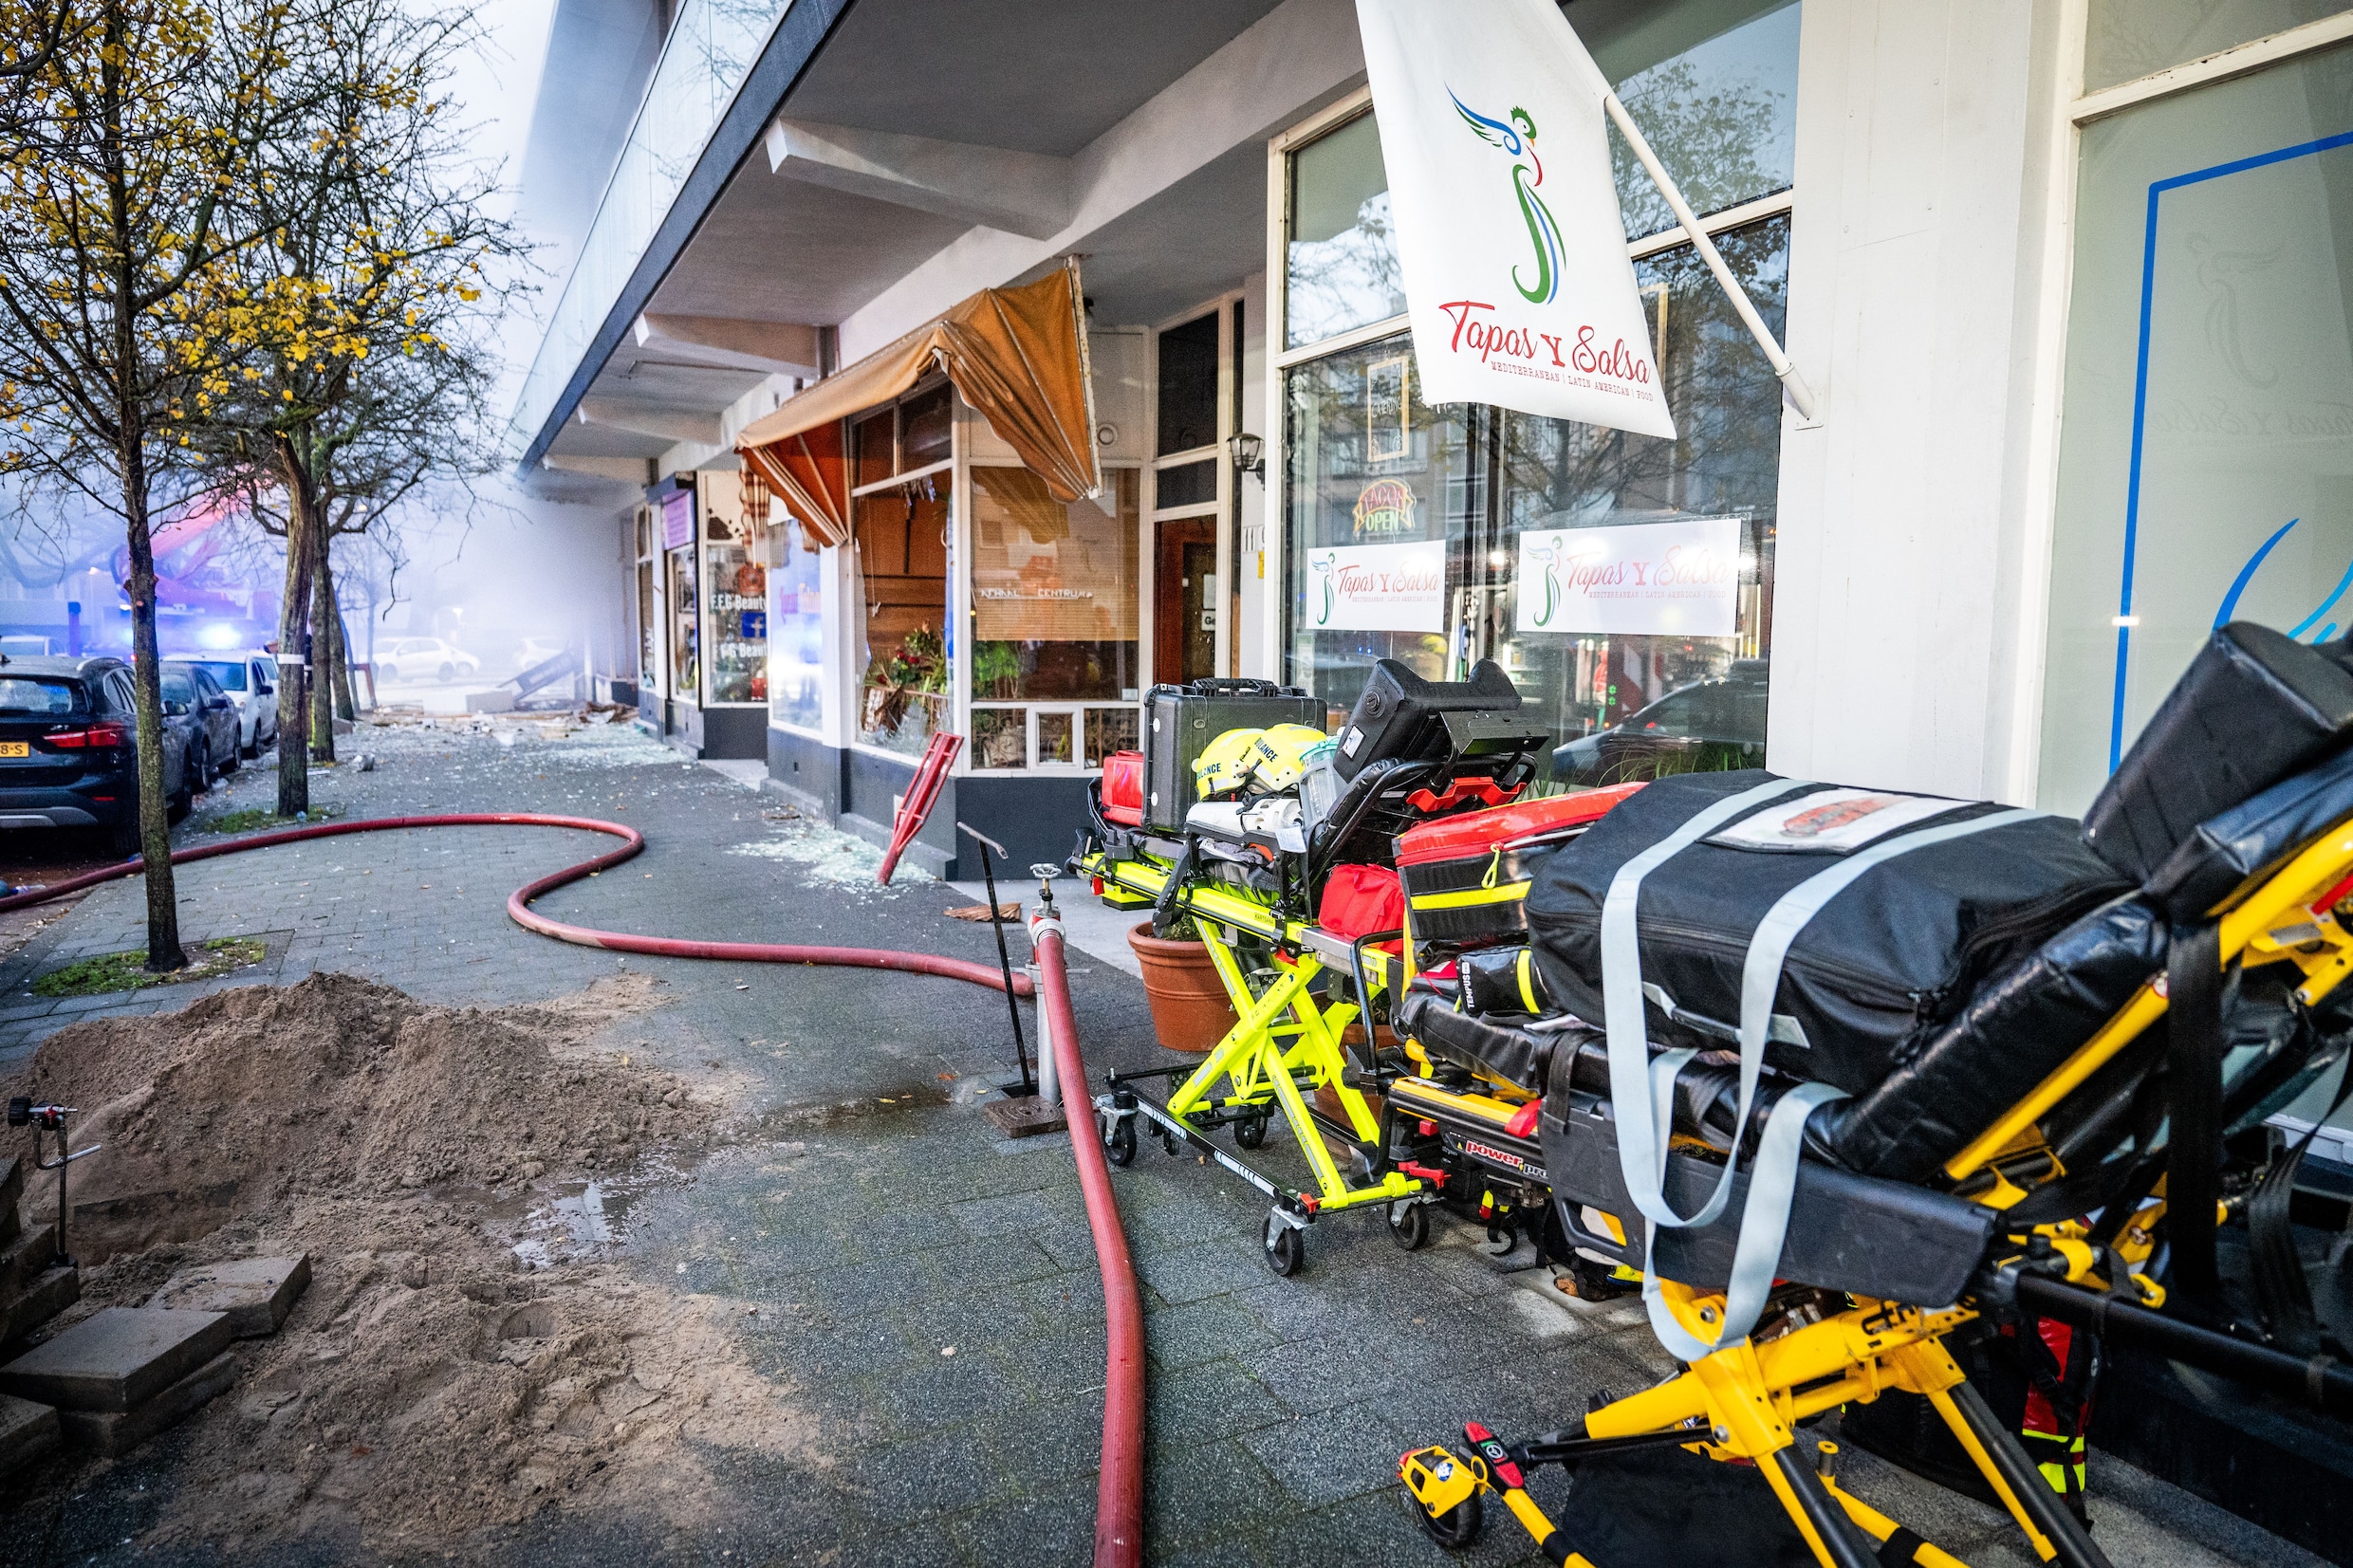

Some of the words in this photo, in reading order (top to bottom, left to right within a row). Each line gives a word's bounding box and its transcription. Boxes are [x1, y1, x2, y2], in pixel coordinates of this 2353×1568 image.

[1438, 300, 1538, 363] Tapas
[1540, 333, 1566, 368] Y
[1572, 324, 1652, 384] Salsa
[1491, 360, 1561, 382] MEDITERRANEAN
[1567, 375, 1592, 389] LATIN
[1594, 380, 1631, 397] AMERICAN
[1636, 390, 1654, 402] FOOD
[1363, 485, 1404, 512] TACOS
[1365, 510, 1399, 532] OPEN
[1337, 564, 1376, 599] Tapas
[1380, 574, 1391, 593] Y
[1392, 561, 1440, 593] Salsa
[1566, 551, 1629, 594] Tapas
[1632, 562, 1649, 586] Y
[1653, 544, 1732, 587] Salsa
[1588, 590, 1640, 599] MEDITERRANEAN
[1644, 590, 1665, 599] LATIN
[1667, 590, 1702, 599] AMERICAN
[1708, 590, 1727, 599] FOOD
[1462, 974, 1475, 1009] TEMPUS
[1466, 1140, 1524, 1168] power
